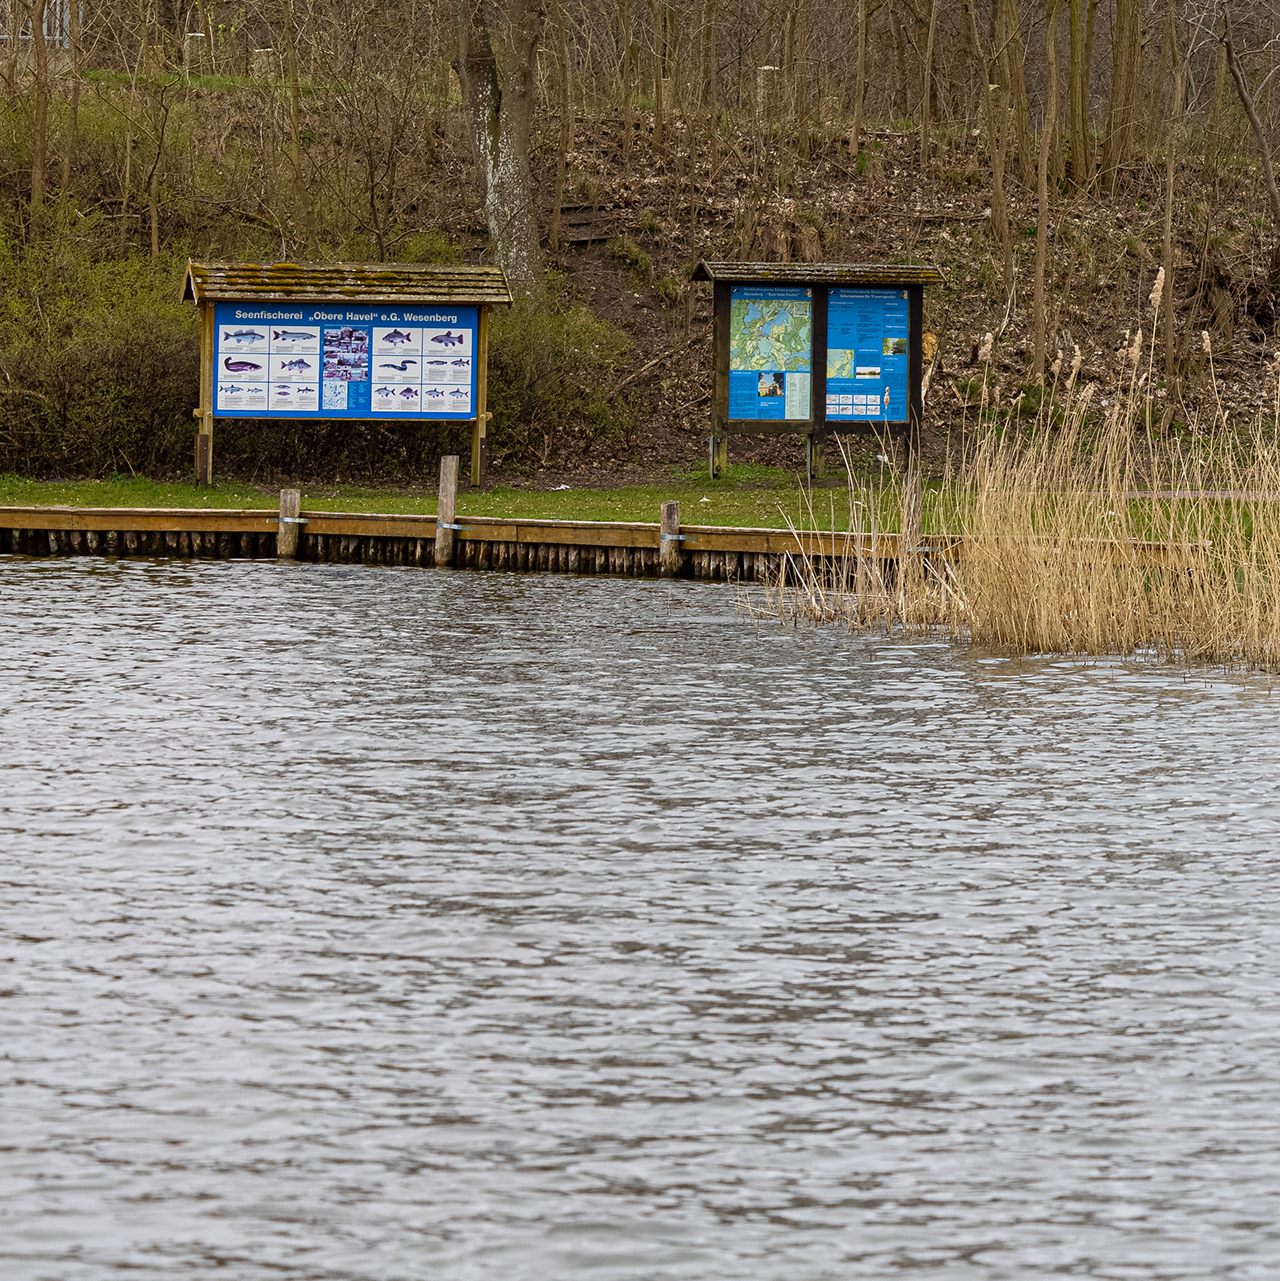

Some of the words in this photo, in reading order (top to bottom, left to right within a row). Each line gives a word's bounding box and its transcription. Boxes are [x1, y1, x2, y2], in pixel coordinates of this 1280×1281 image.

[235, 310, 303, 320] Seenfischerei
[308, 311, 343, 321] „Obere
[380, 312, 400, 321] e.G.
[403, 312, 458, 324] Wesenberg
